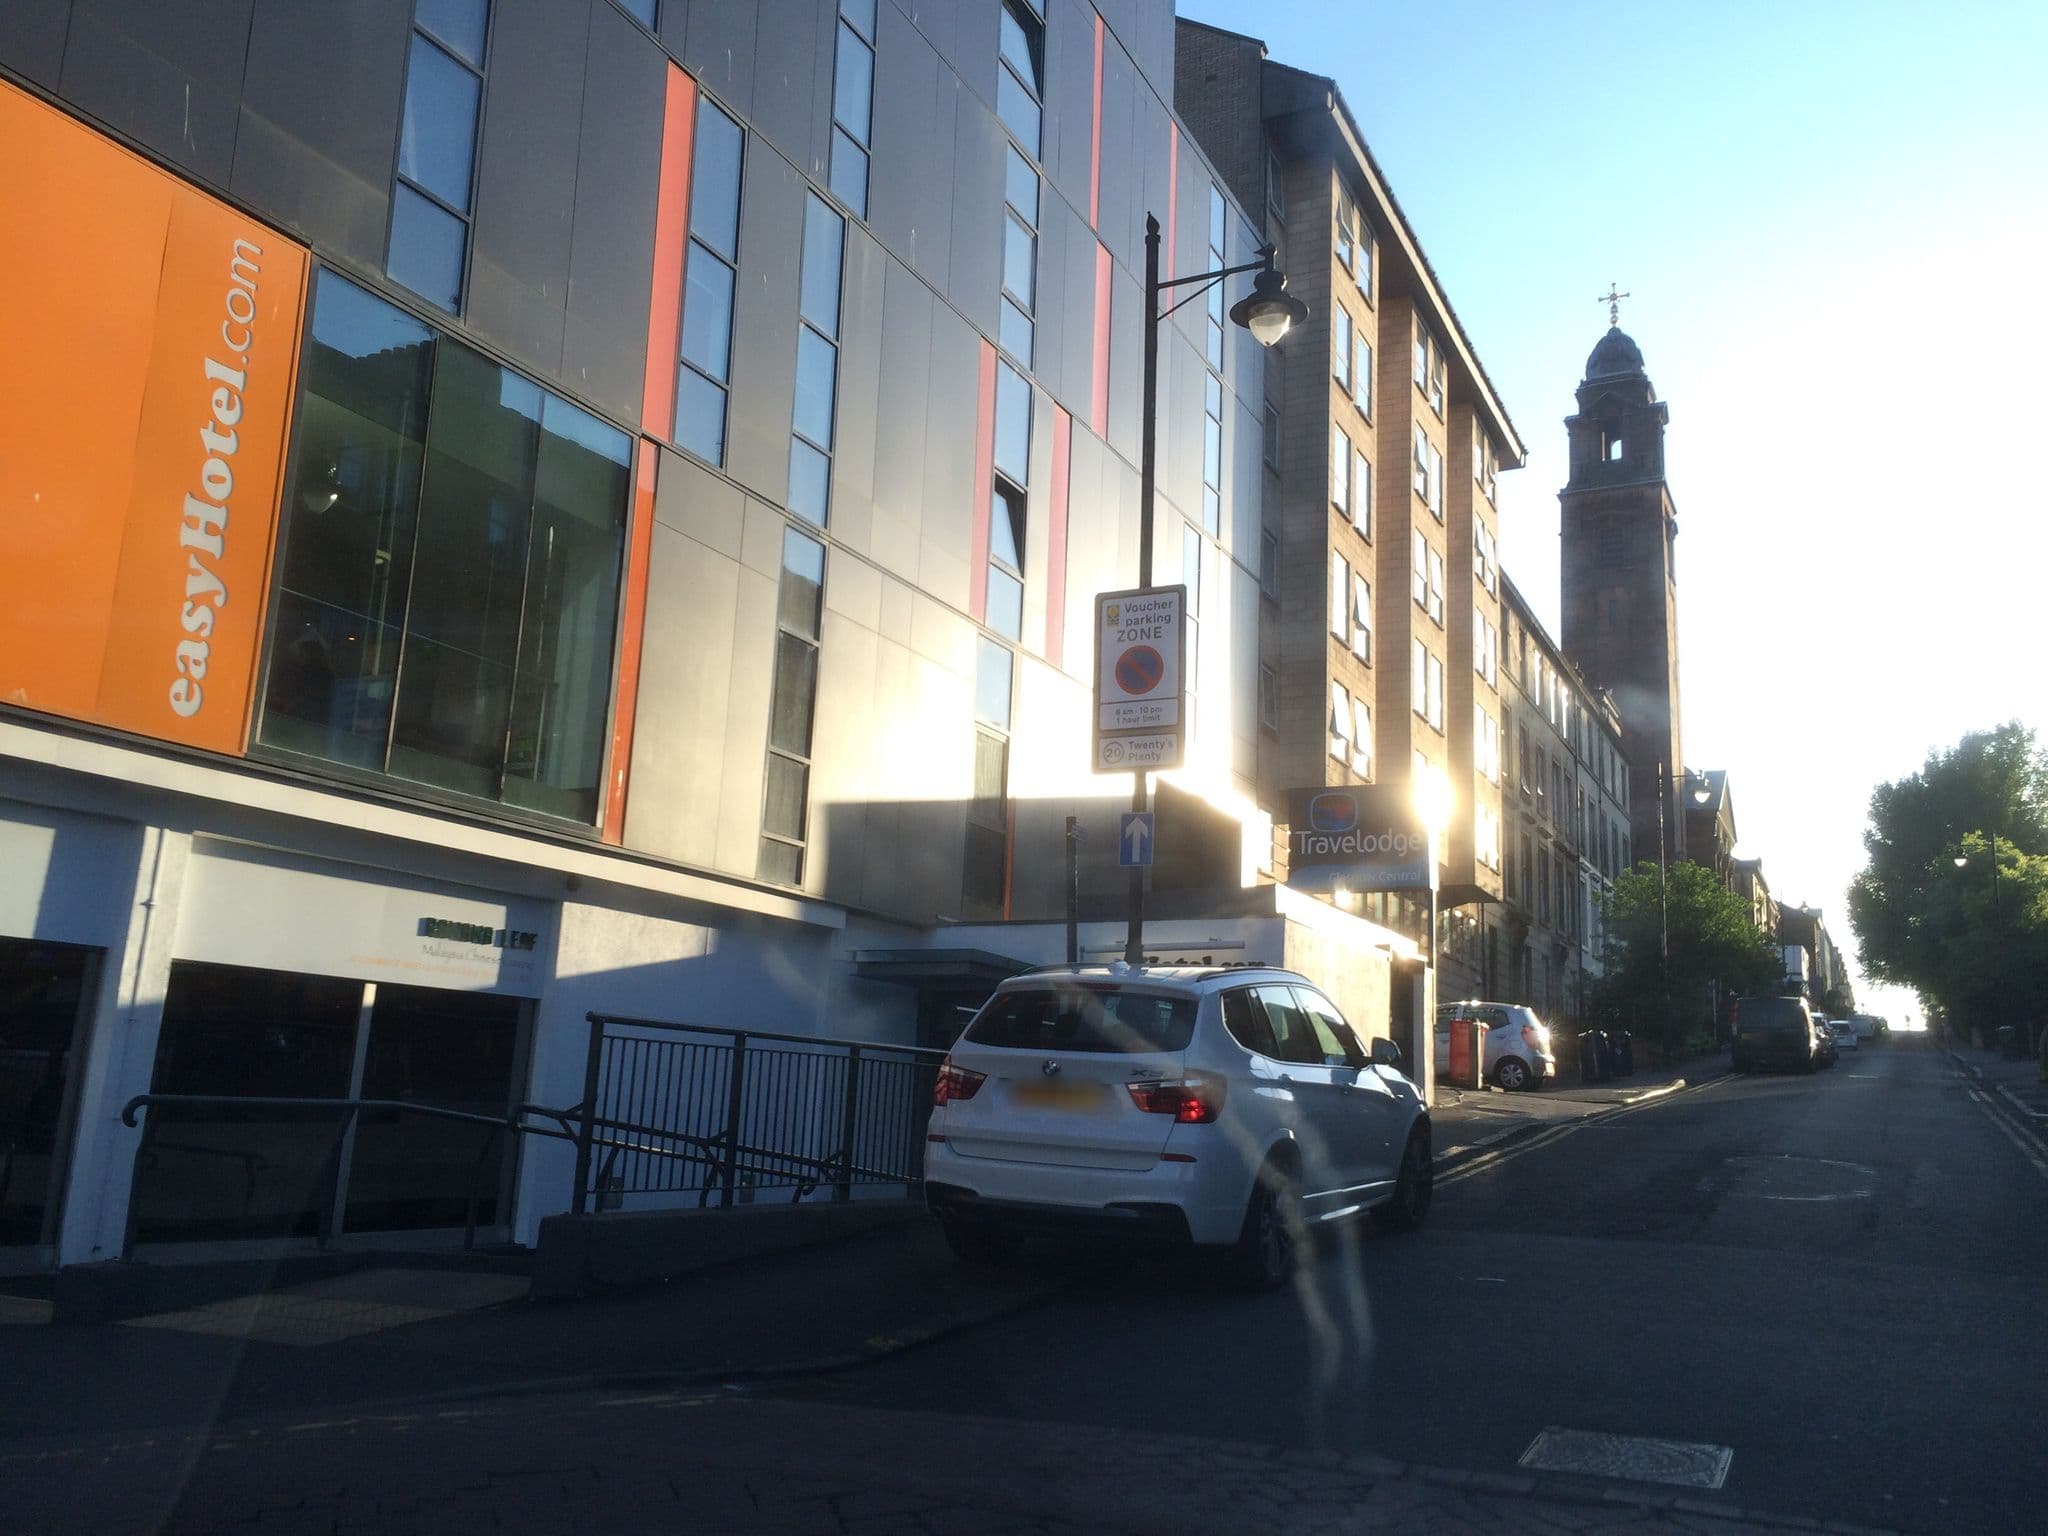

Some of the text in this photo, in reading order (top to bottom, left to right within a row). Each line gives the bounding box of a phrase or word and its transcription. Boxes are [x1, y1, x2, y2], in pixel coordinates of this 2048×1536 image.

[169, 237, 264, 717] easyHotel.com
[1124, 600, 1174, 613] Voucher
[1125, 612, 1172, 627] parking
[1117, 627, 1162, 642] ZONE
[1139, 706, 1149, 714] 10
[1121, 716, 1140, 724] hour
[1128, 738, 1173, 751] Twenty's
[1106, 747, 1121, 758] 20
[1128, 751, 1161, 762] Plenty
[1295, 828, 1422, 857] Travelodge
